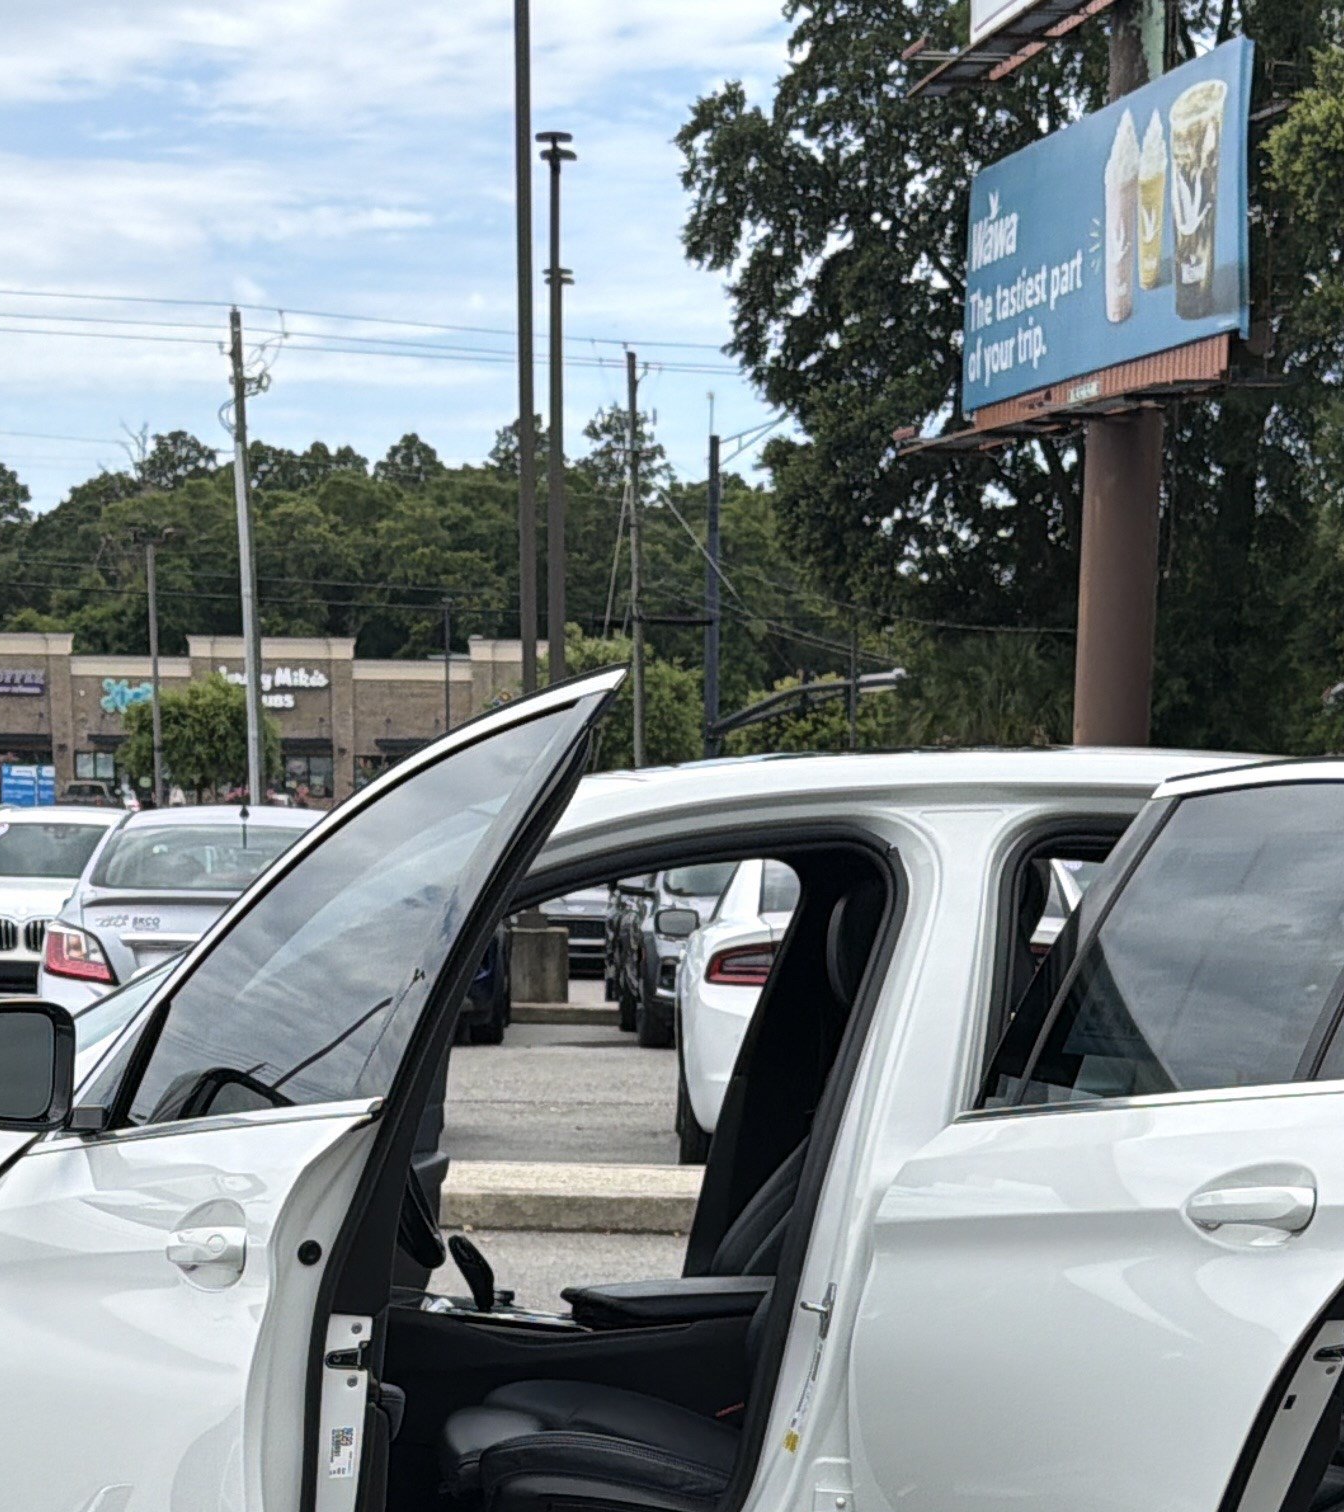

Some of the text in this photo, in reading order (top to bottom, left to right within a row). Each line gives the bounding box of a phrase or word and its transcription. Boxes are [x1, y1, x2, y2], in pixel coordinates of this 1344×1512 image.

[972, 212, 1018, 272] Wawa
[970, 249, 1083, 332] The tastiest part
[968, 316, 1047, 388] of your trip.
